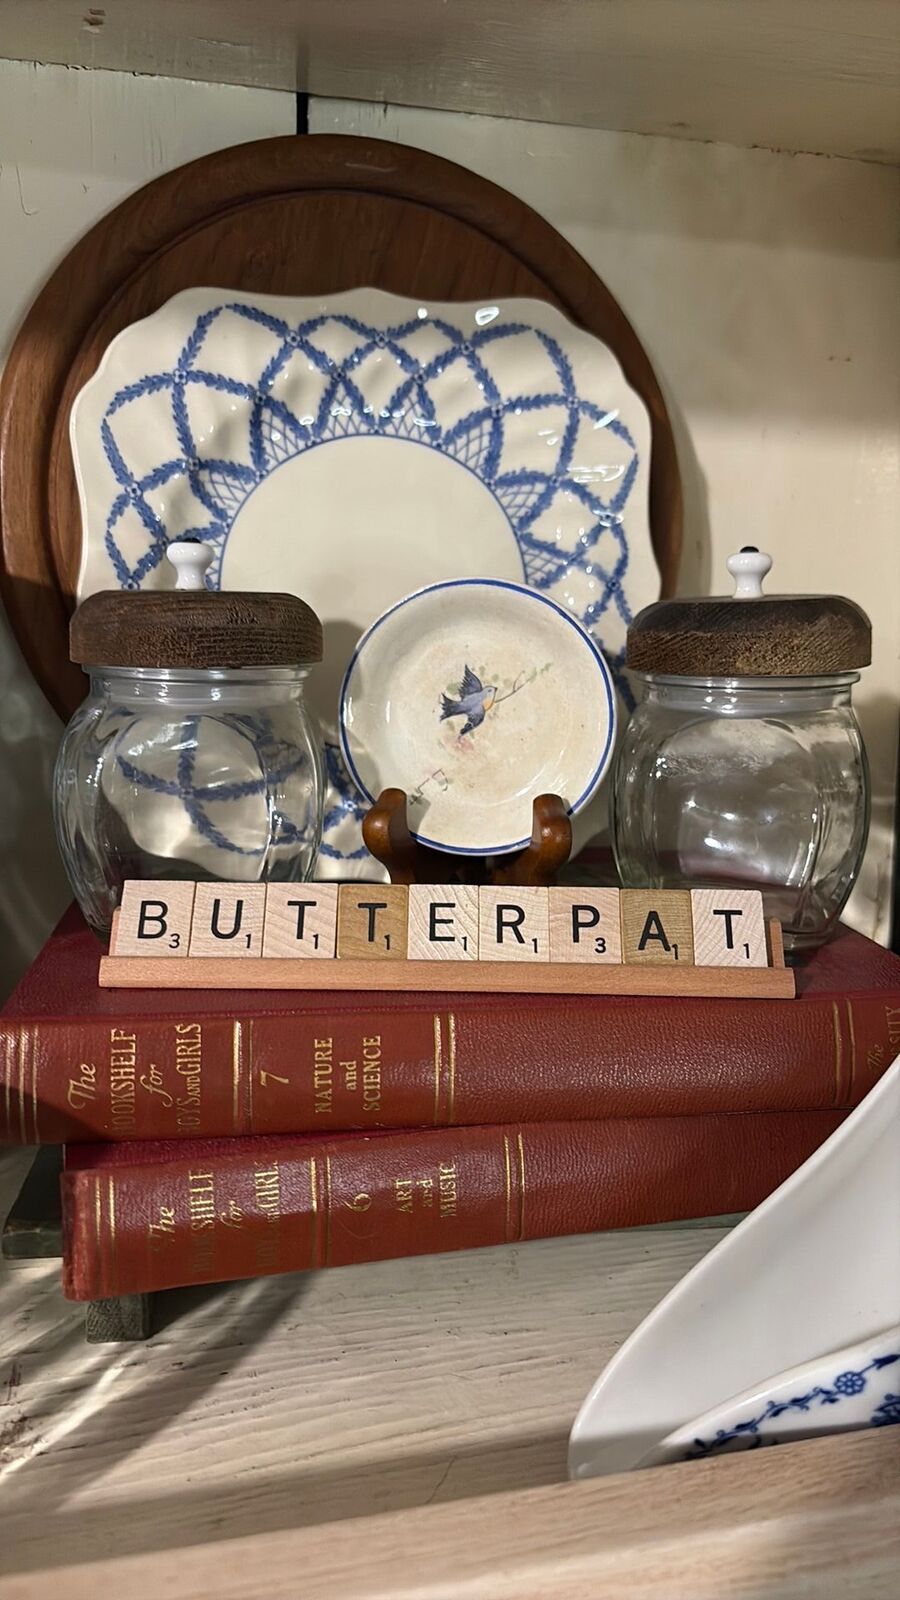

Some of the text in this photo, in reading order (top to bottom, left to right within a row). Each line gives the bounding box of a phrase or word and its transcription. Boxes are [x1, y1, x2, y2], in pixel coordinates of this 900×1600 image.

[67, 1063, 96, 1109] The
[140, 1063, 173, 1108] for
[260, 1070, 289, 1087] 7
[314, 1037, 333, 1113] NATURE
[339, 1060, 357, 1091] and
[363, 1035, 381, 1111] SCIENCE
[343, 1192, 372, 1213] 6
[394, 1178, 414, 1214] ART
[439, 1158, 457, 1218] MUSIC
